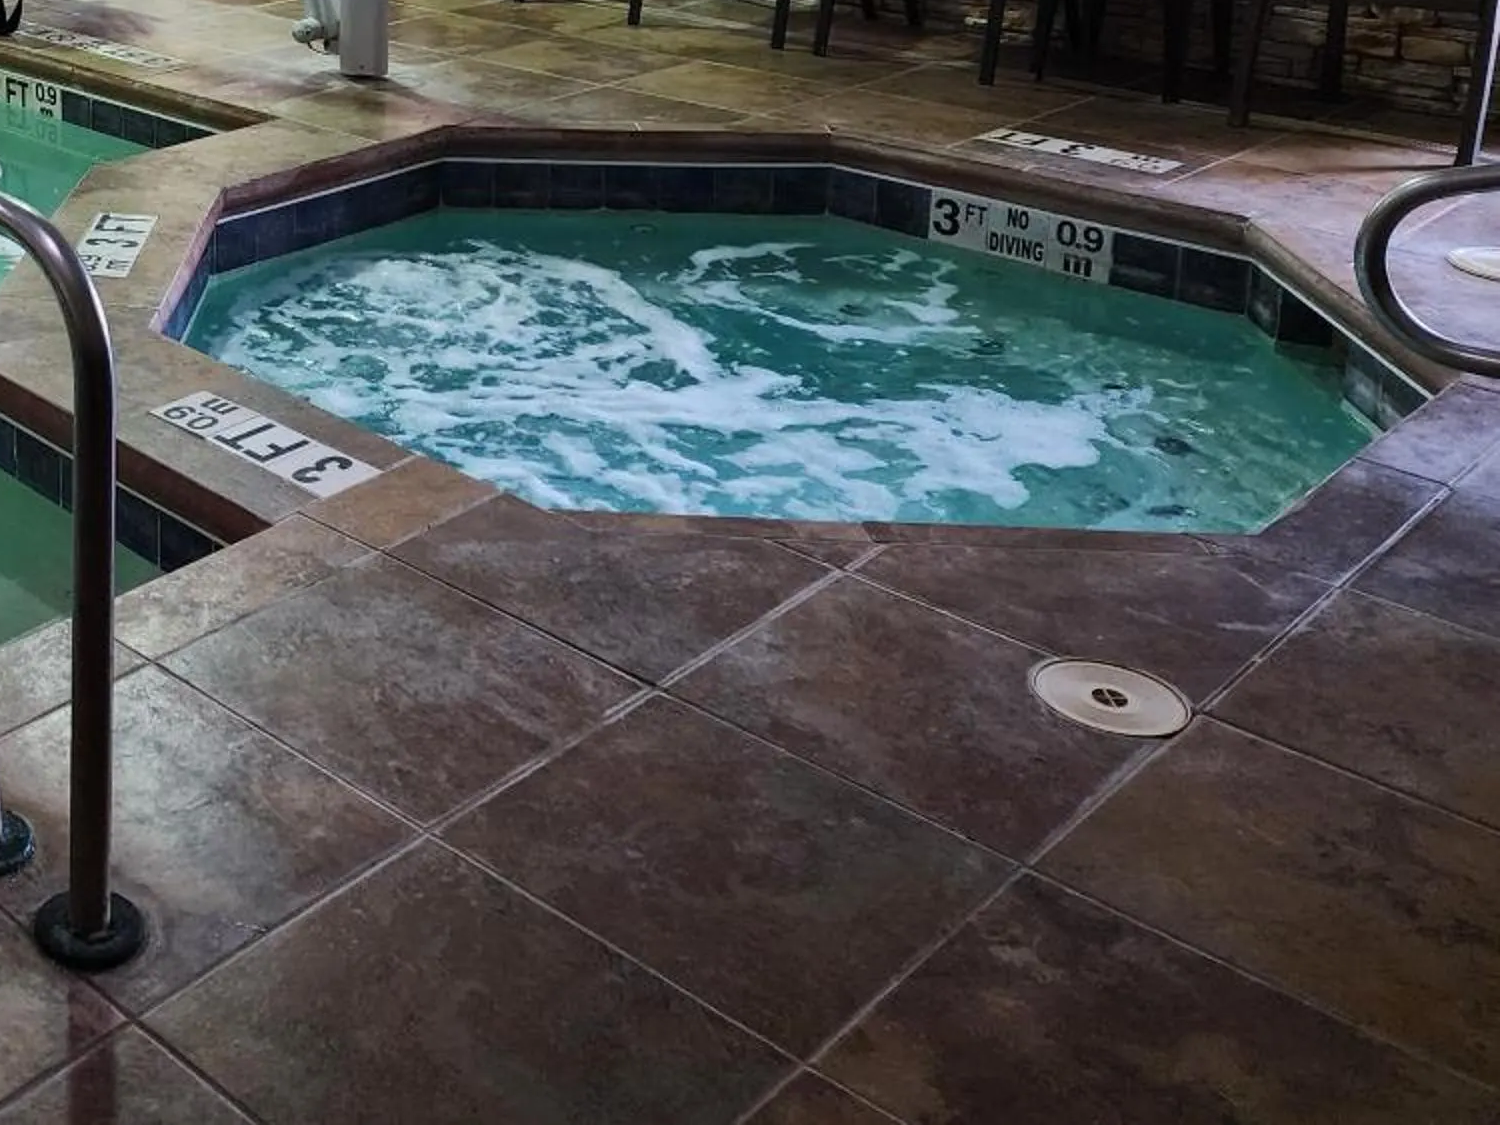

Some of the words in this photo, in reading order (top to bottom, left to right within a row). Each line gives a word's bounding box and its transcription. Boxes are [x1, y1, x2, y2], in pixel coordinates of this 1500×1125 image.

[6, 77, 29, 107] FT
[95, 215, 153, 234] FT
[933, 198, 960, 236] 3
[965, 203, 988, 225] FT
[1007, 207, 1029, 230] NO
[86, 238, 139, 248] 3
[989, 232, 1045, 262] DIVING
[1056, 220, 1104, 252] 0.9
[1063, 253, 1093, 277] m
[214, 423, 310, 463] FT
[291, 456, 353, 484] 3
